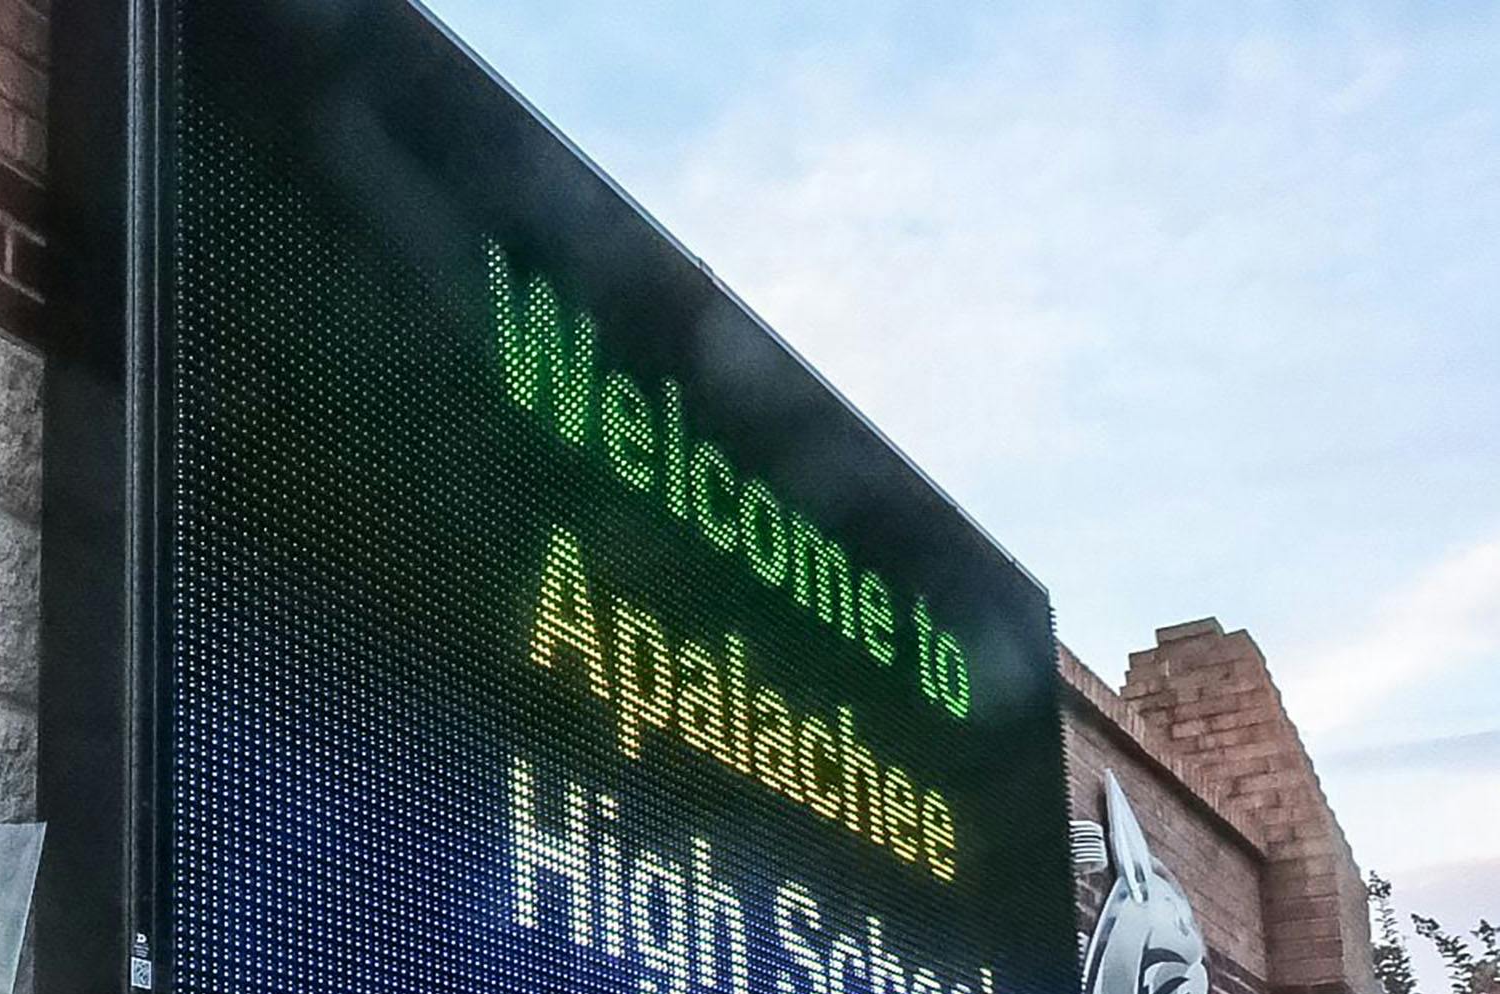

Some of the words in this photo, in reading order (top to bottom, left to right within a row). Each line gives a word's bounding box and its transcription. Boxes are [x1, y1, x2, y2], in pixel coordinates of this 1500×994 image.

[483, 233, 894, 668] Welcome
[912, 595, 970, 721] to
[529, 522, 956, 882] Apalachee
